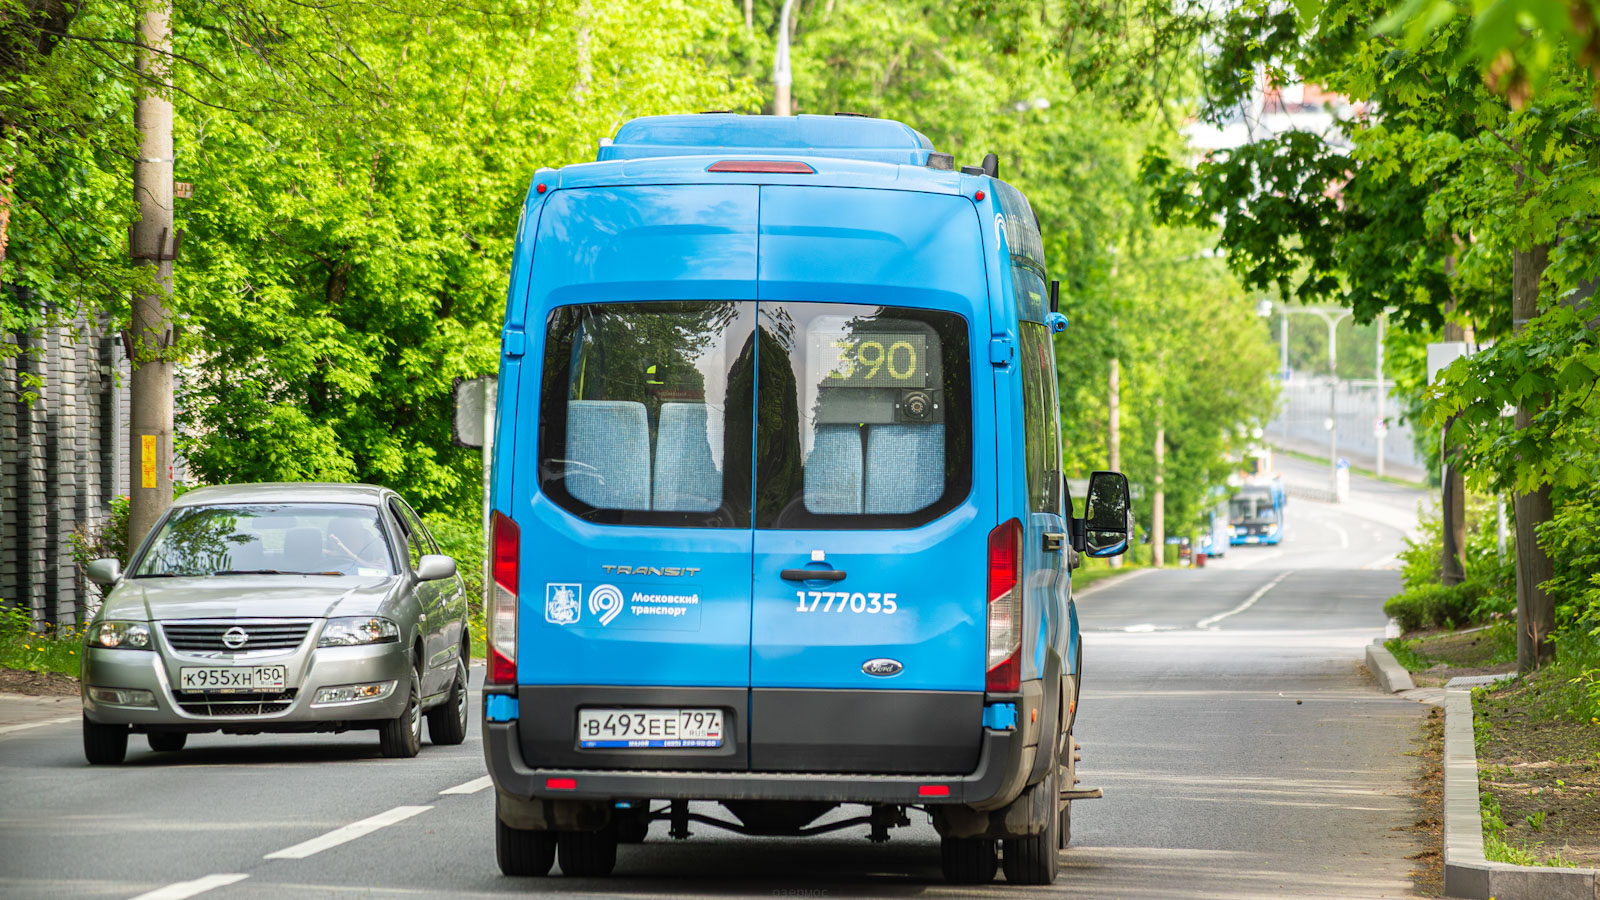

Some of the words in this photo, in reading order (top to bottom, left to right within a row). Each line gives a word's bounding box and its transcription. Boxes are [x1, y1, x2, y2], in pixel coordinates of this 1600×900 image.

[829, 340, 917, 380] 390
[602, 564, 701, 577] TRANSIT
[631, 592, 699, 604] Московский
[796, 590, 898, 614] 1777035
[631, 606, 687, 617] транспорт
[870, 661, 894, 673] Ford
[255, 668, 280, 680] 150
[682, 713, 717, 729] 797
[689, 729, 706, 737] RUS
